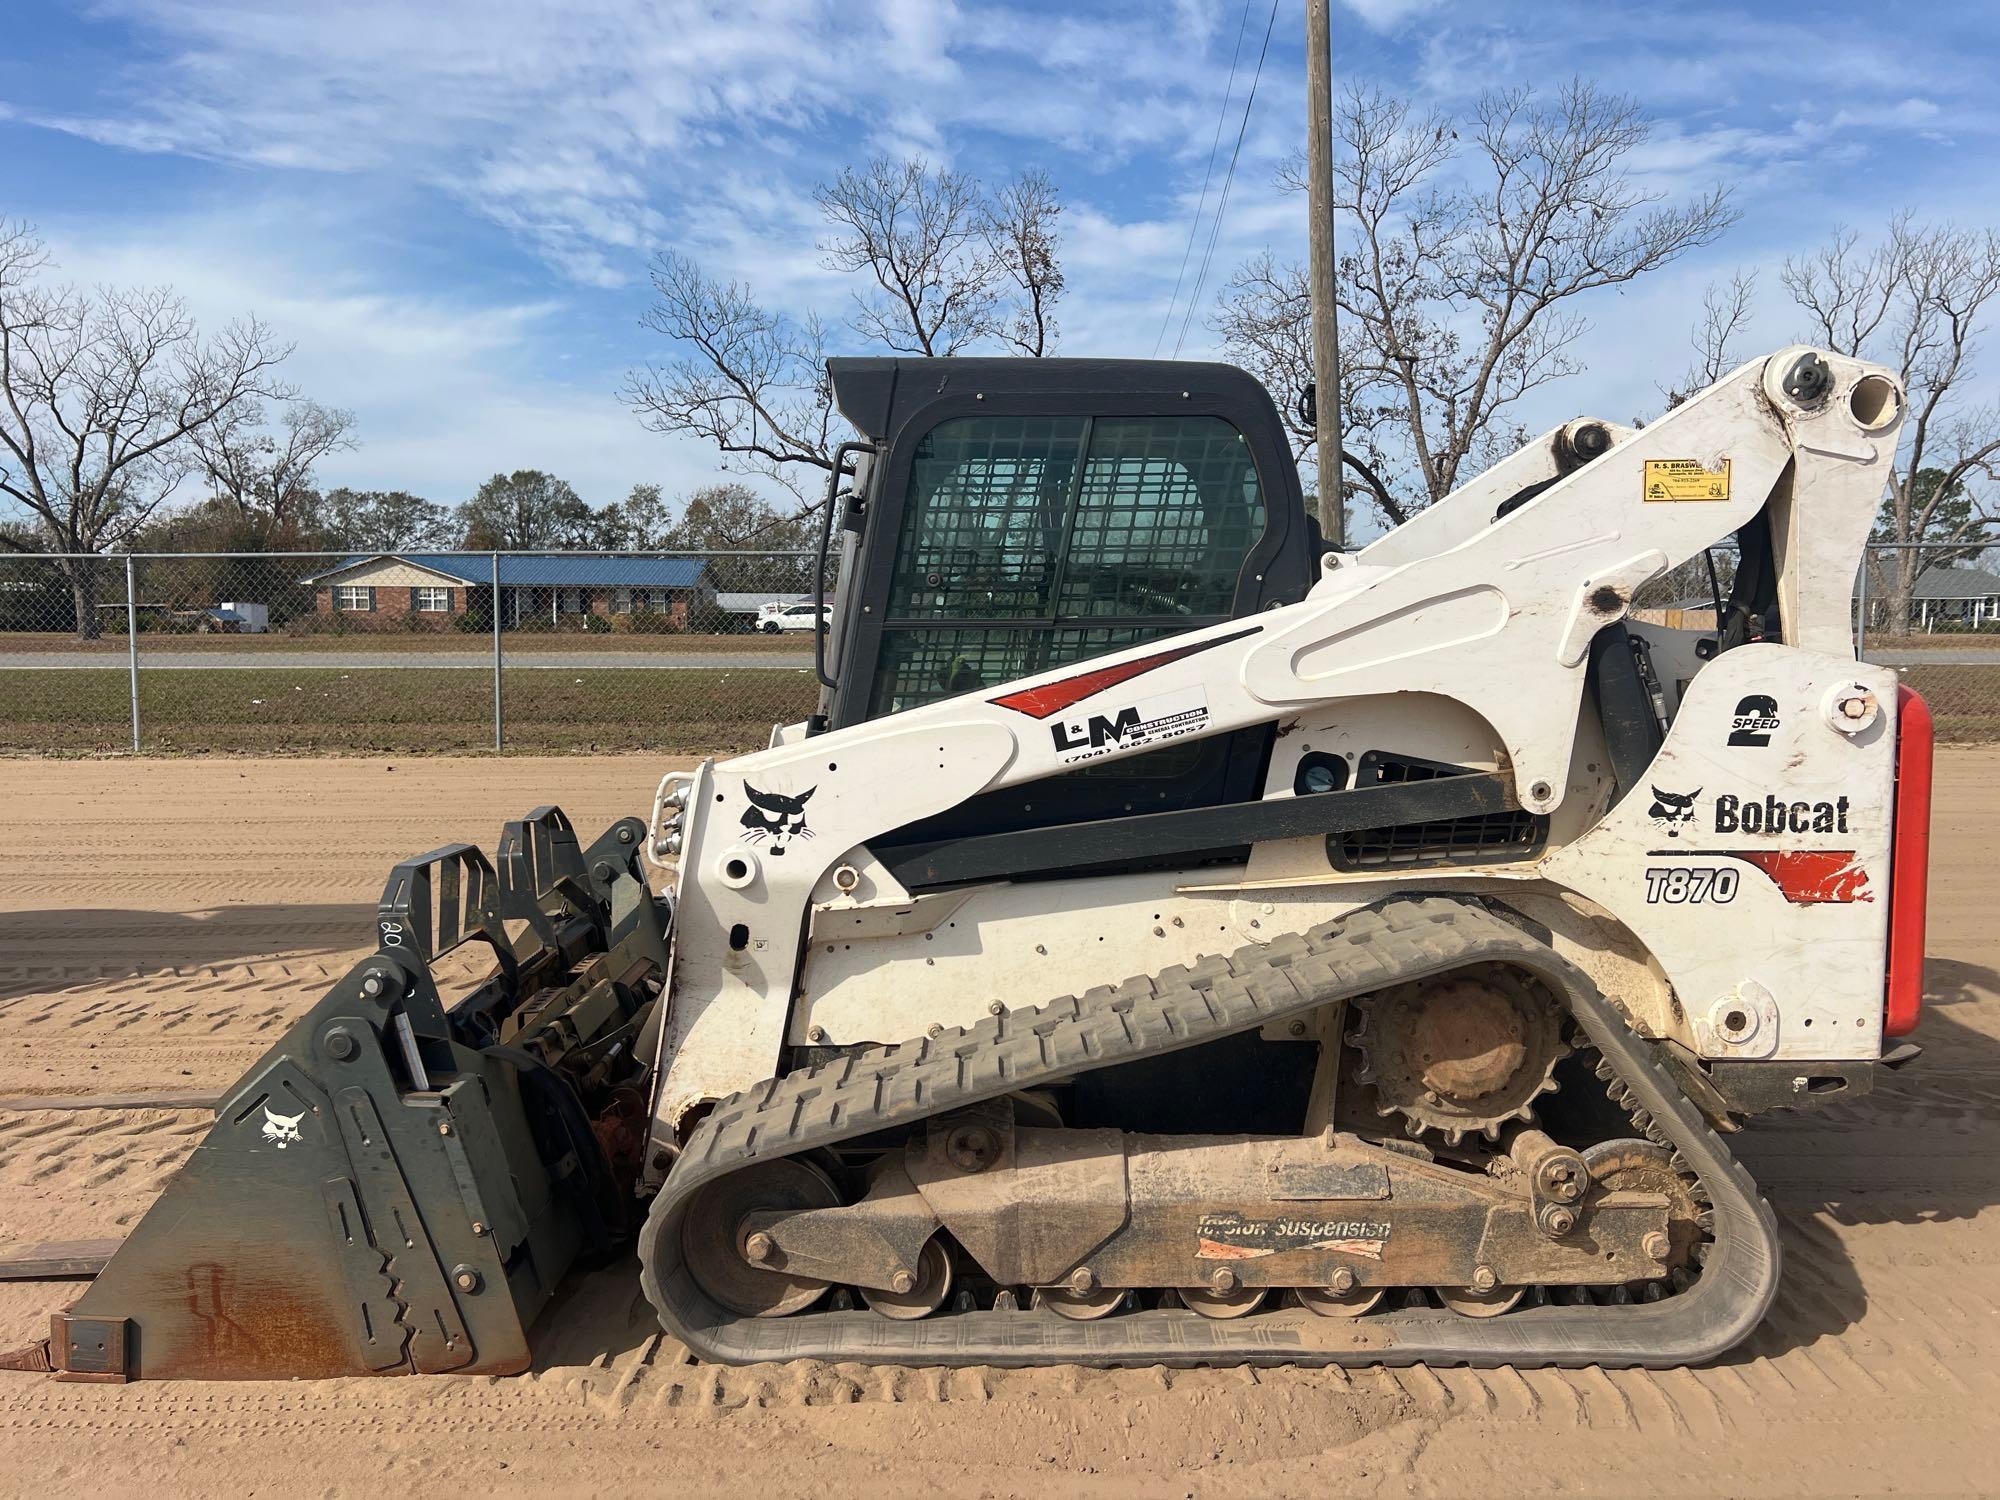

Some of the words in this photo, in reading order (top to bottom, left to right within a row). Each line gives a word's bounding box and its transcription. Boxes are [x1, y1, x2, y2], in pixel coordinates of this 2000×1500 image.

[1124, 707, 1206, 735] CONSTRUCTION
[1147, 725, 1171, 735] GENERAL
[1170, 715, 1210, 729] CONTRACTORS
[1727, 695, 1778, 747] 2
[1731, 718, 1780, 729] SPEED
[1064, 748, 1112, 764] (704)
[1118, 723, 1207, 750] 662-8057
[1714, 794, 1850, 834] Bobcat
[1646, 867, 1740, 904] T870
